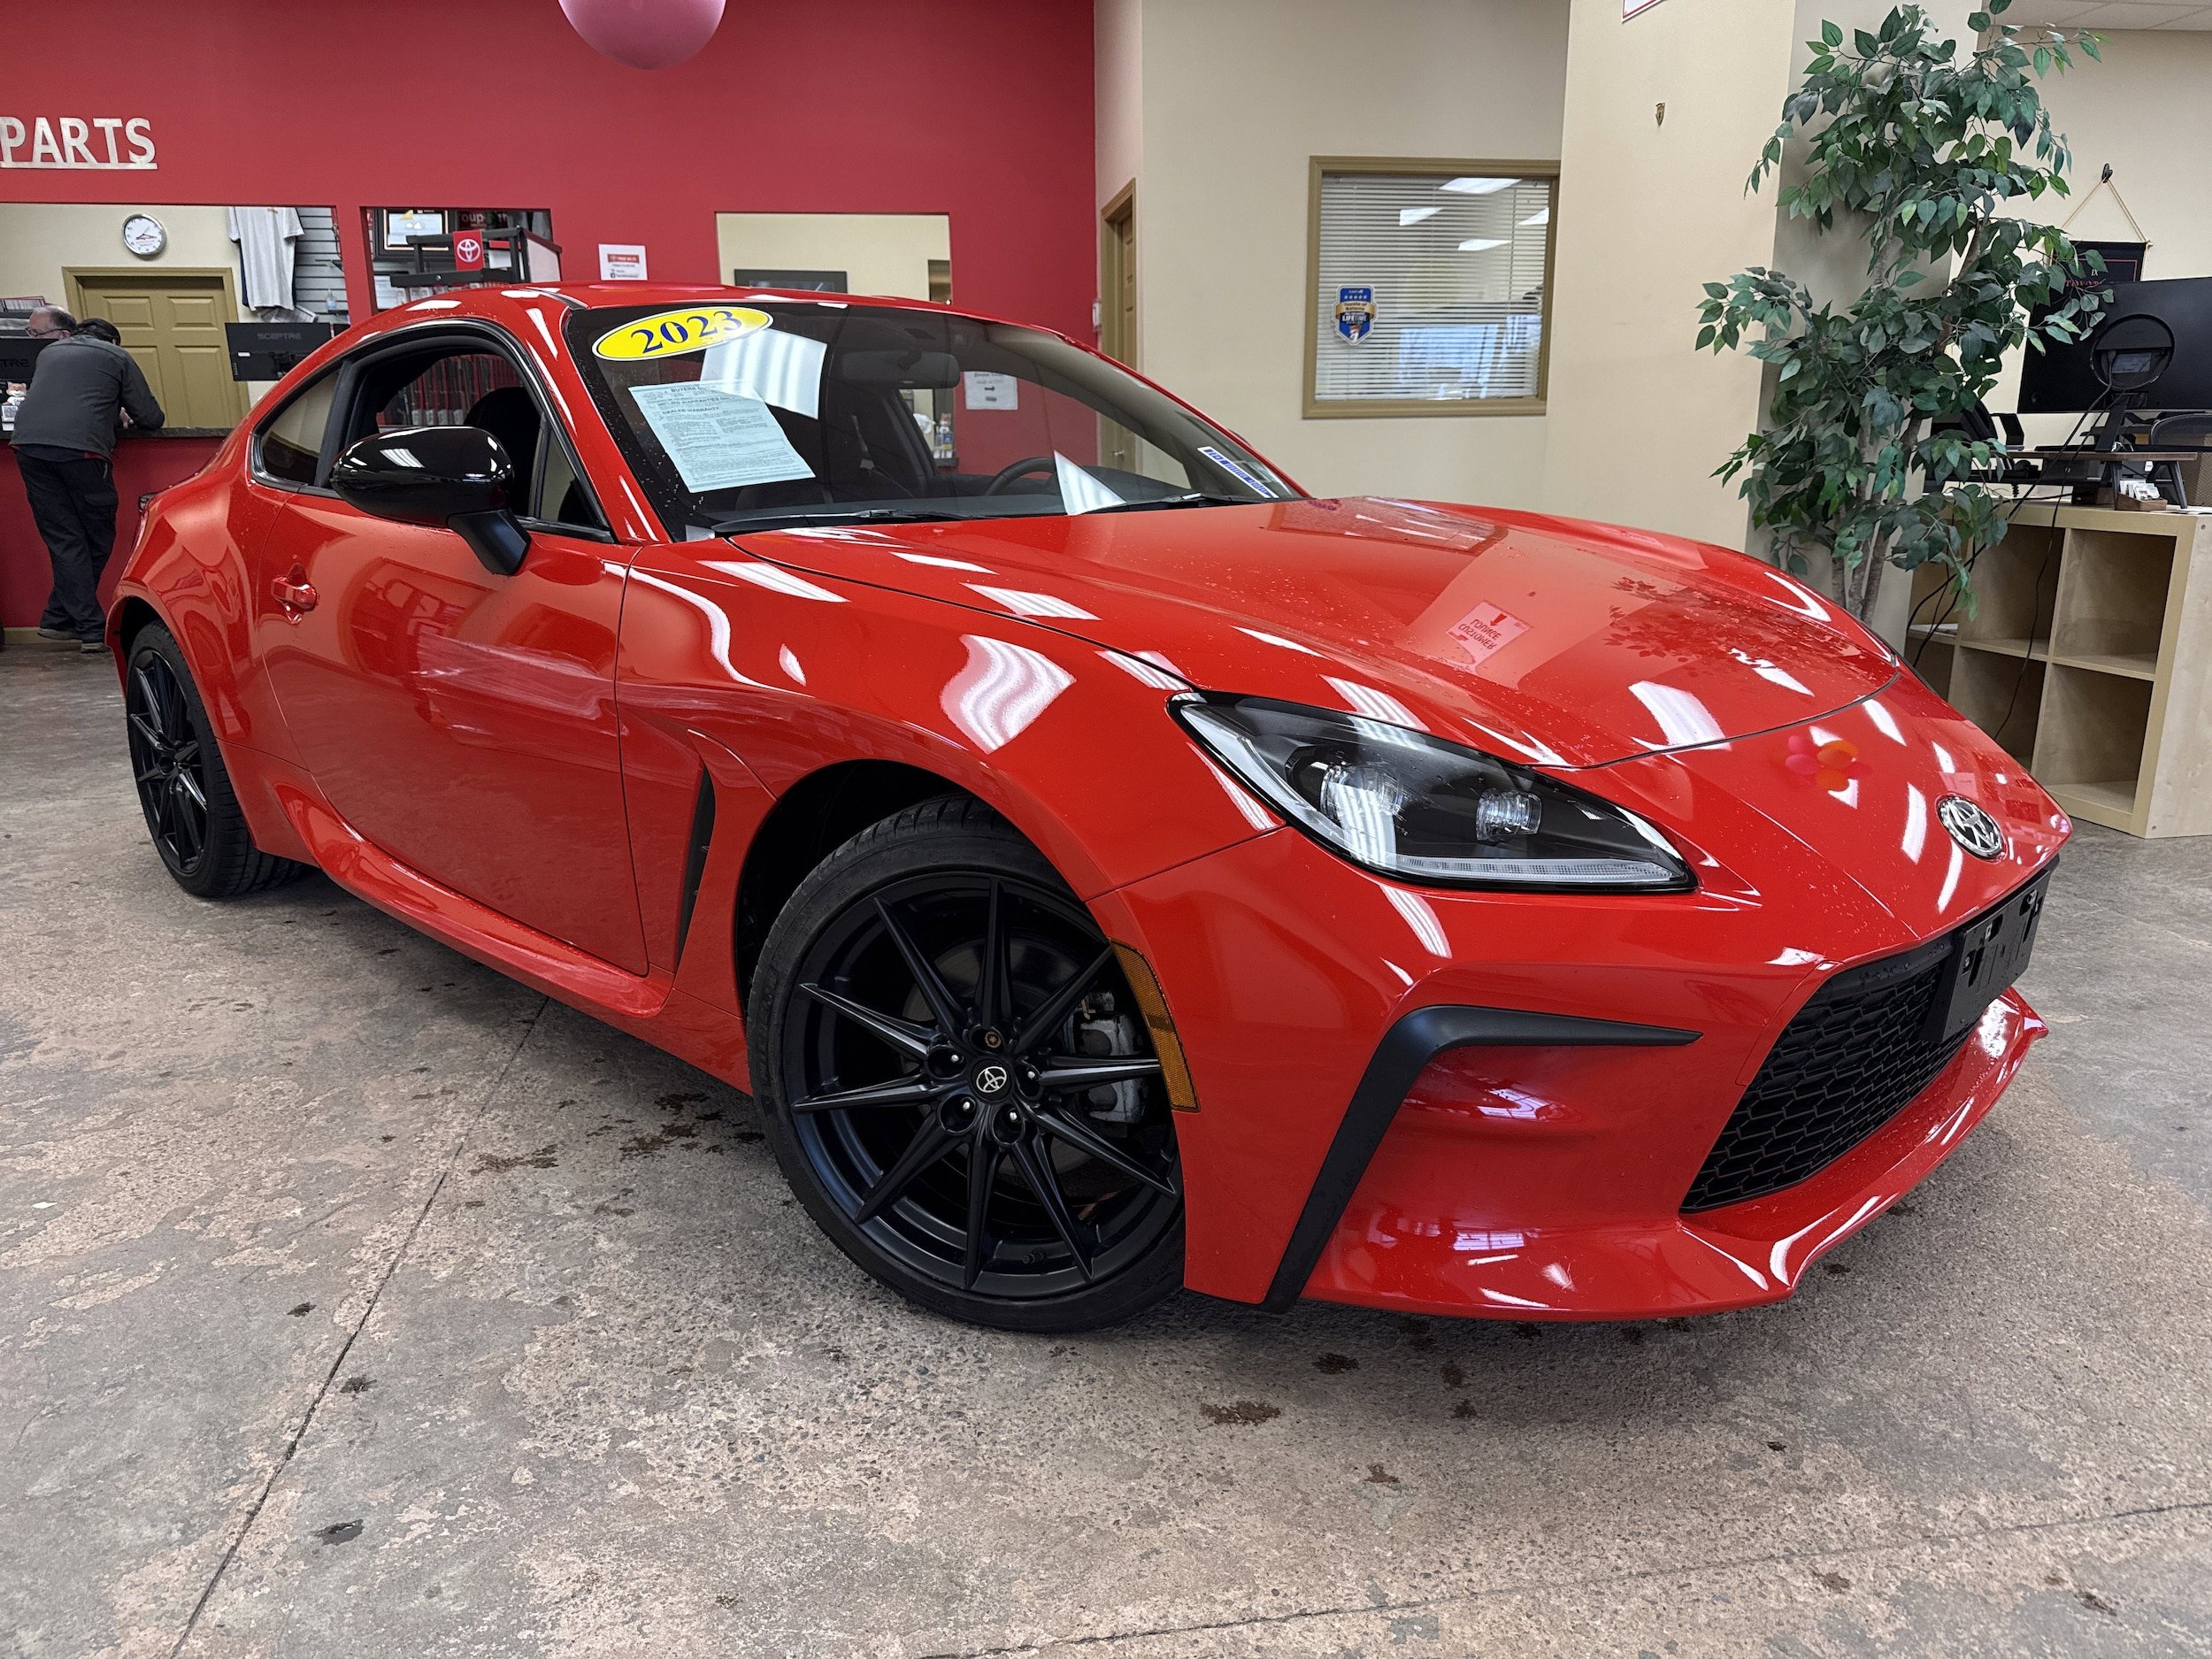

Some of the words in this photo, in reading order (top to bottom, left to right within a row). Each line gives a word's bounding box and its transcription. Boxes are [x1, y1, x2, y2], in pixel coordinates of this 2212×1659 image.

[0, 116, 157, 166] PARTS
[257, 332, 303, 341] SCEPTRE
[631, 311, 742, 353] 2023
